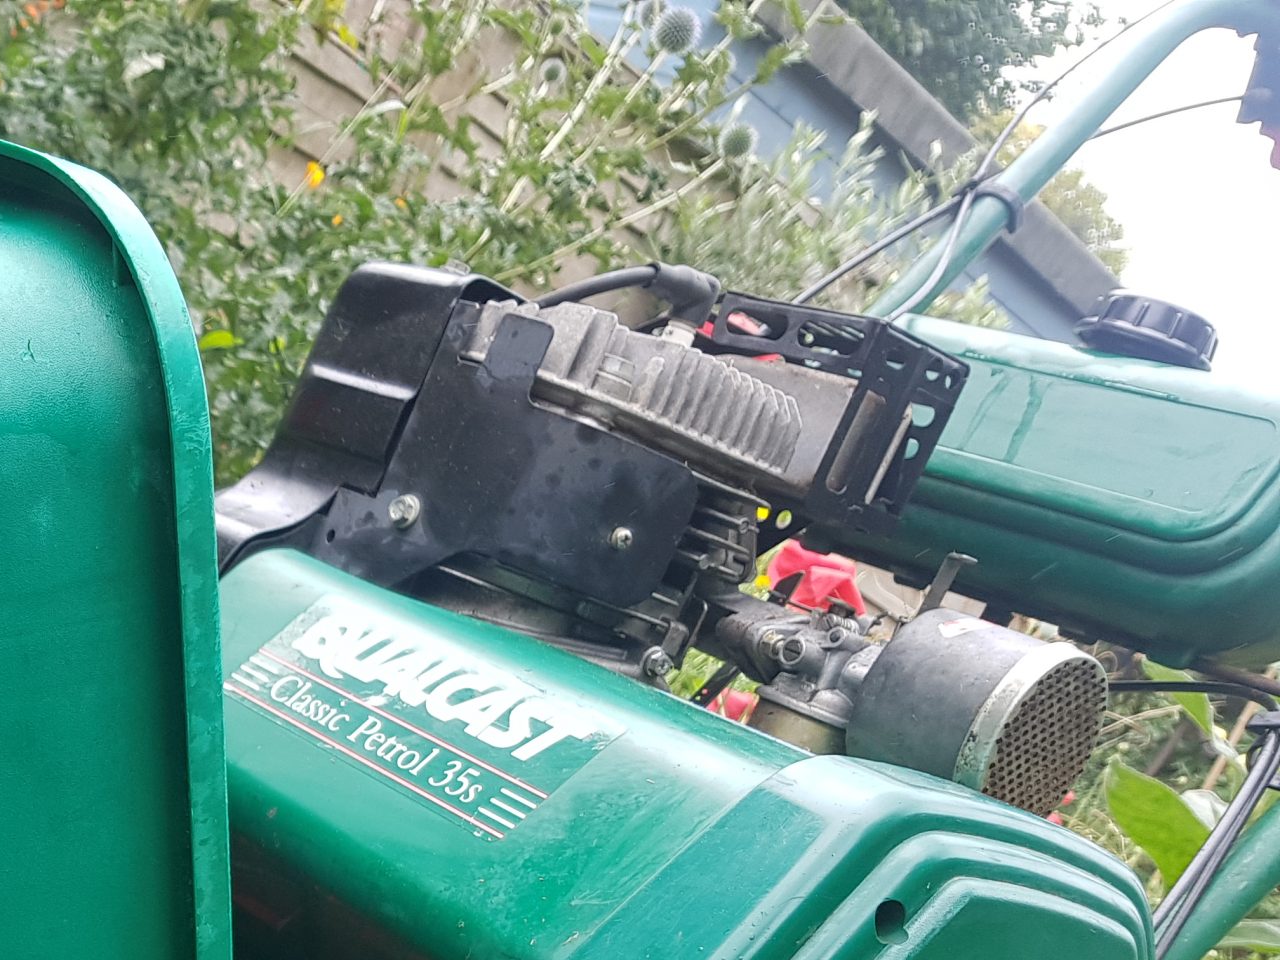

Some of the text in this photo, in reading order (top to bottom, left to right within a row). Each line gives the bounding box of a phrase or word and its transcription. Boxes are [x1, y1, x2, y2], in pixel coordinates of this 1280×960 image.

[270, 675, 483, 803] Classic Petrol 35s
[292, 611, 591, 762] QUALCAST
